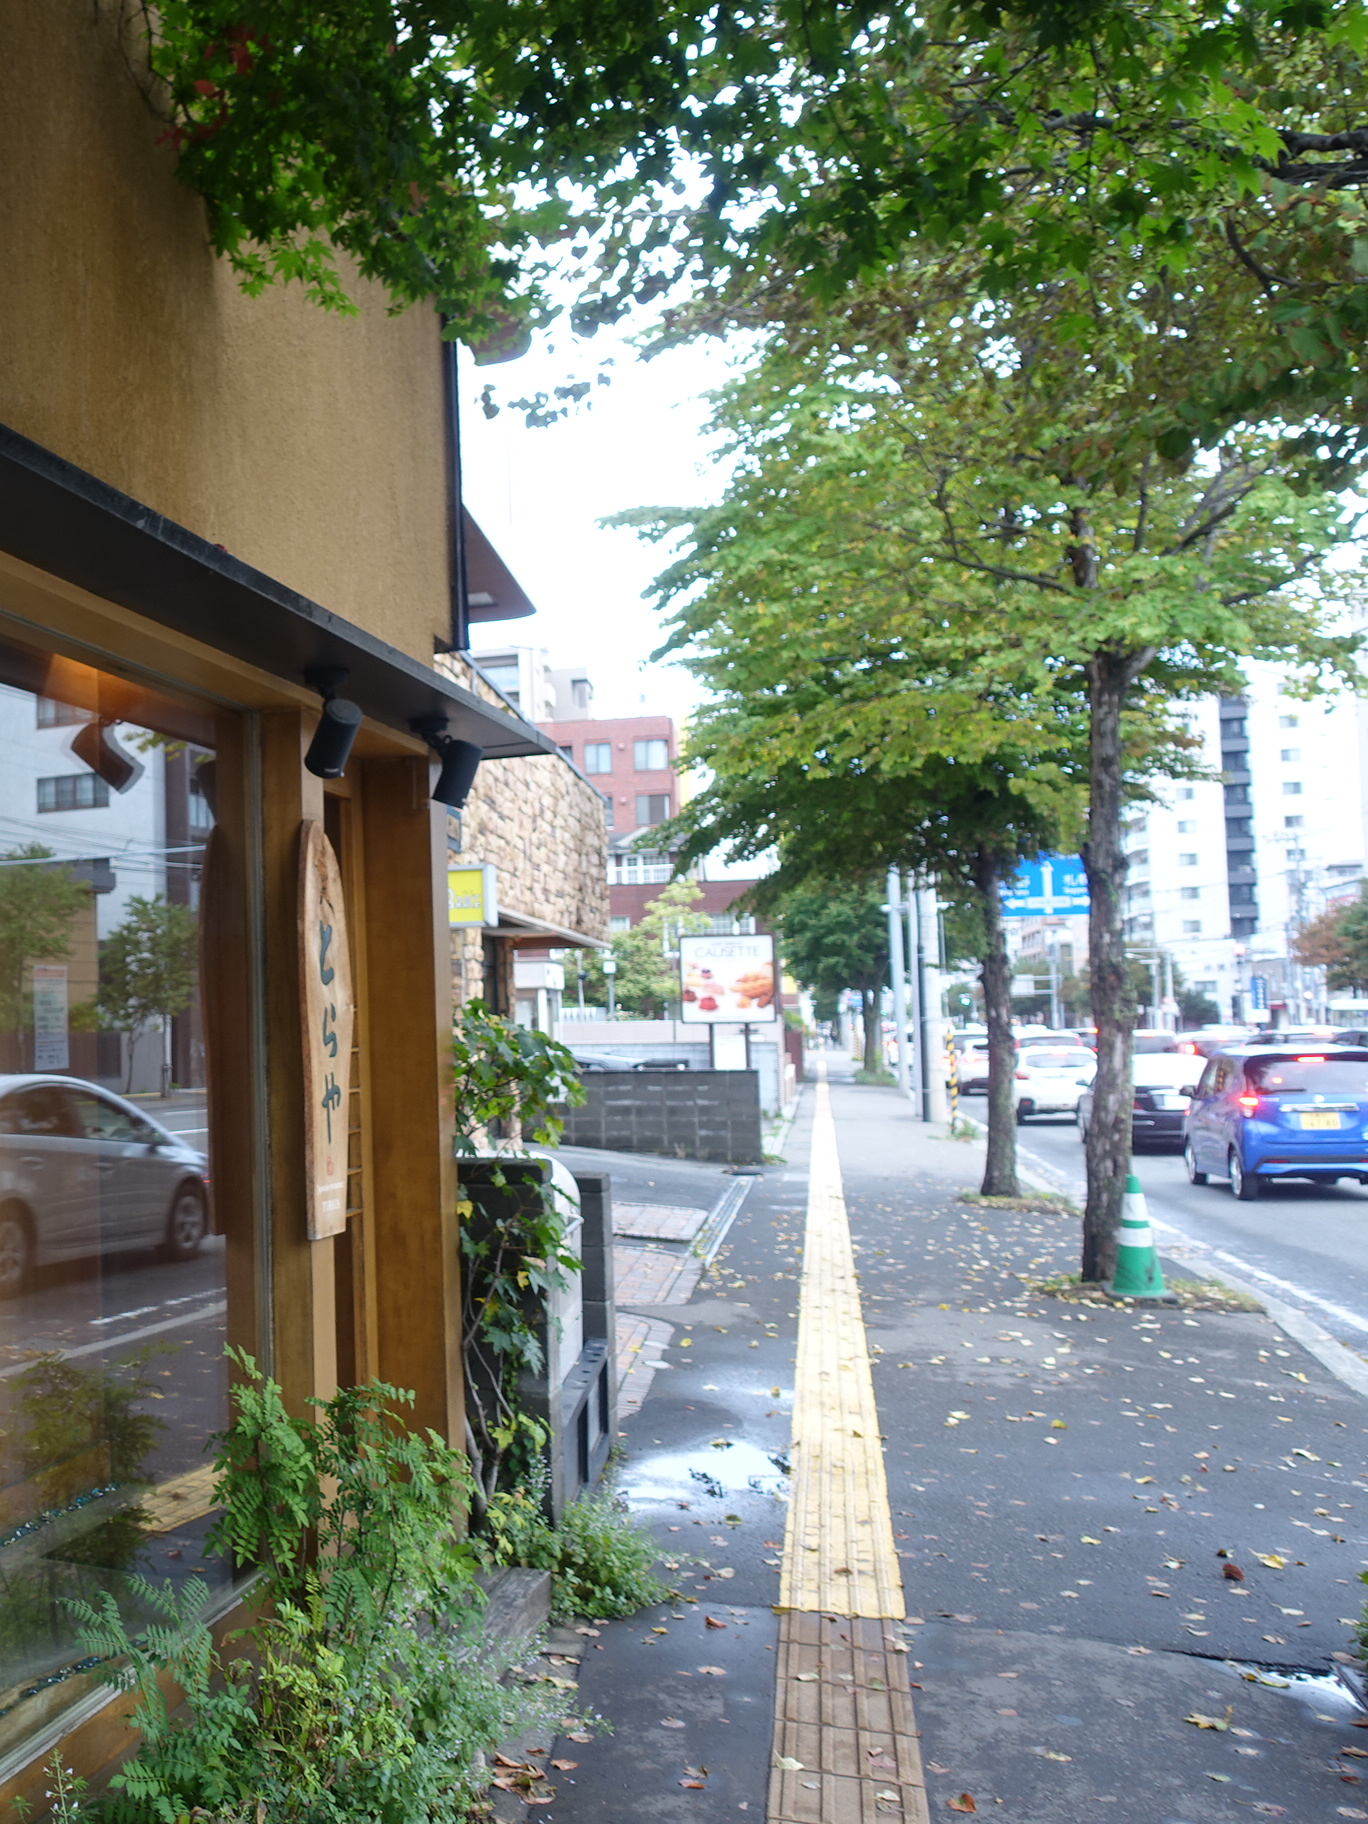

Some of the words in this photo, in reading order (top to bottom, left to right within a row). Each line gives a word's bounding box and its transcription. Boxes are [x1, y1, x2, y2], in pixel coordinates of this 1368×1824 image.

[694, 945, 761, 959] CAUSETTE
[319, 919, 342, 1145] とらや
